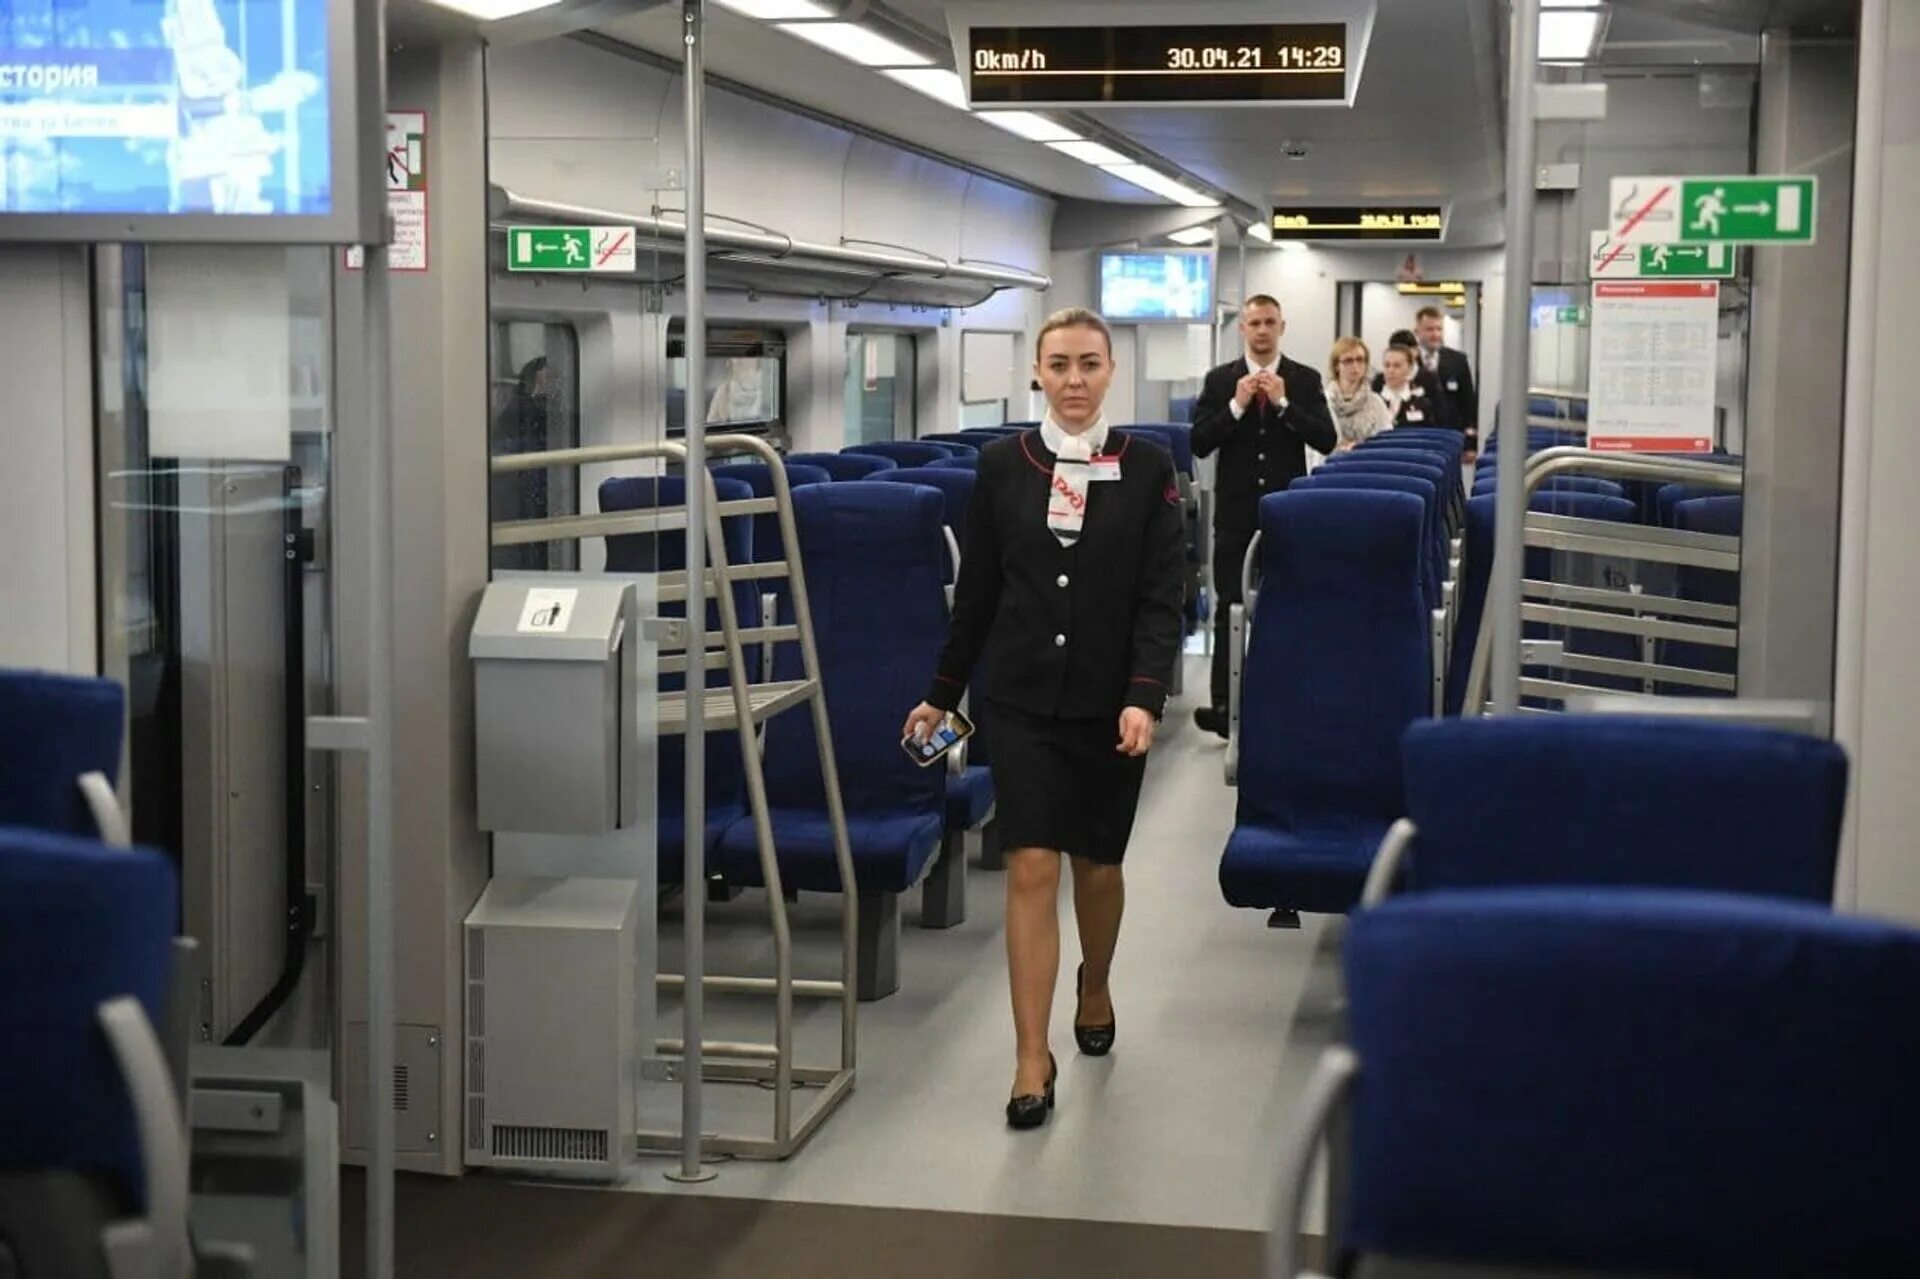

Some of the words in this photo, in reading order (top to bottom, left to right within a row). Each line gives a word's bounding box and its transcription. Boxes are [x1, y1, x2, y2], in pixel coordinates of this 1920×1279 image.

[975, 49, 1046, 69] 0km/h
[1167, 47, 1262, 69] 30.04.21
[1277, 46, 1341, 67] 14:29
